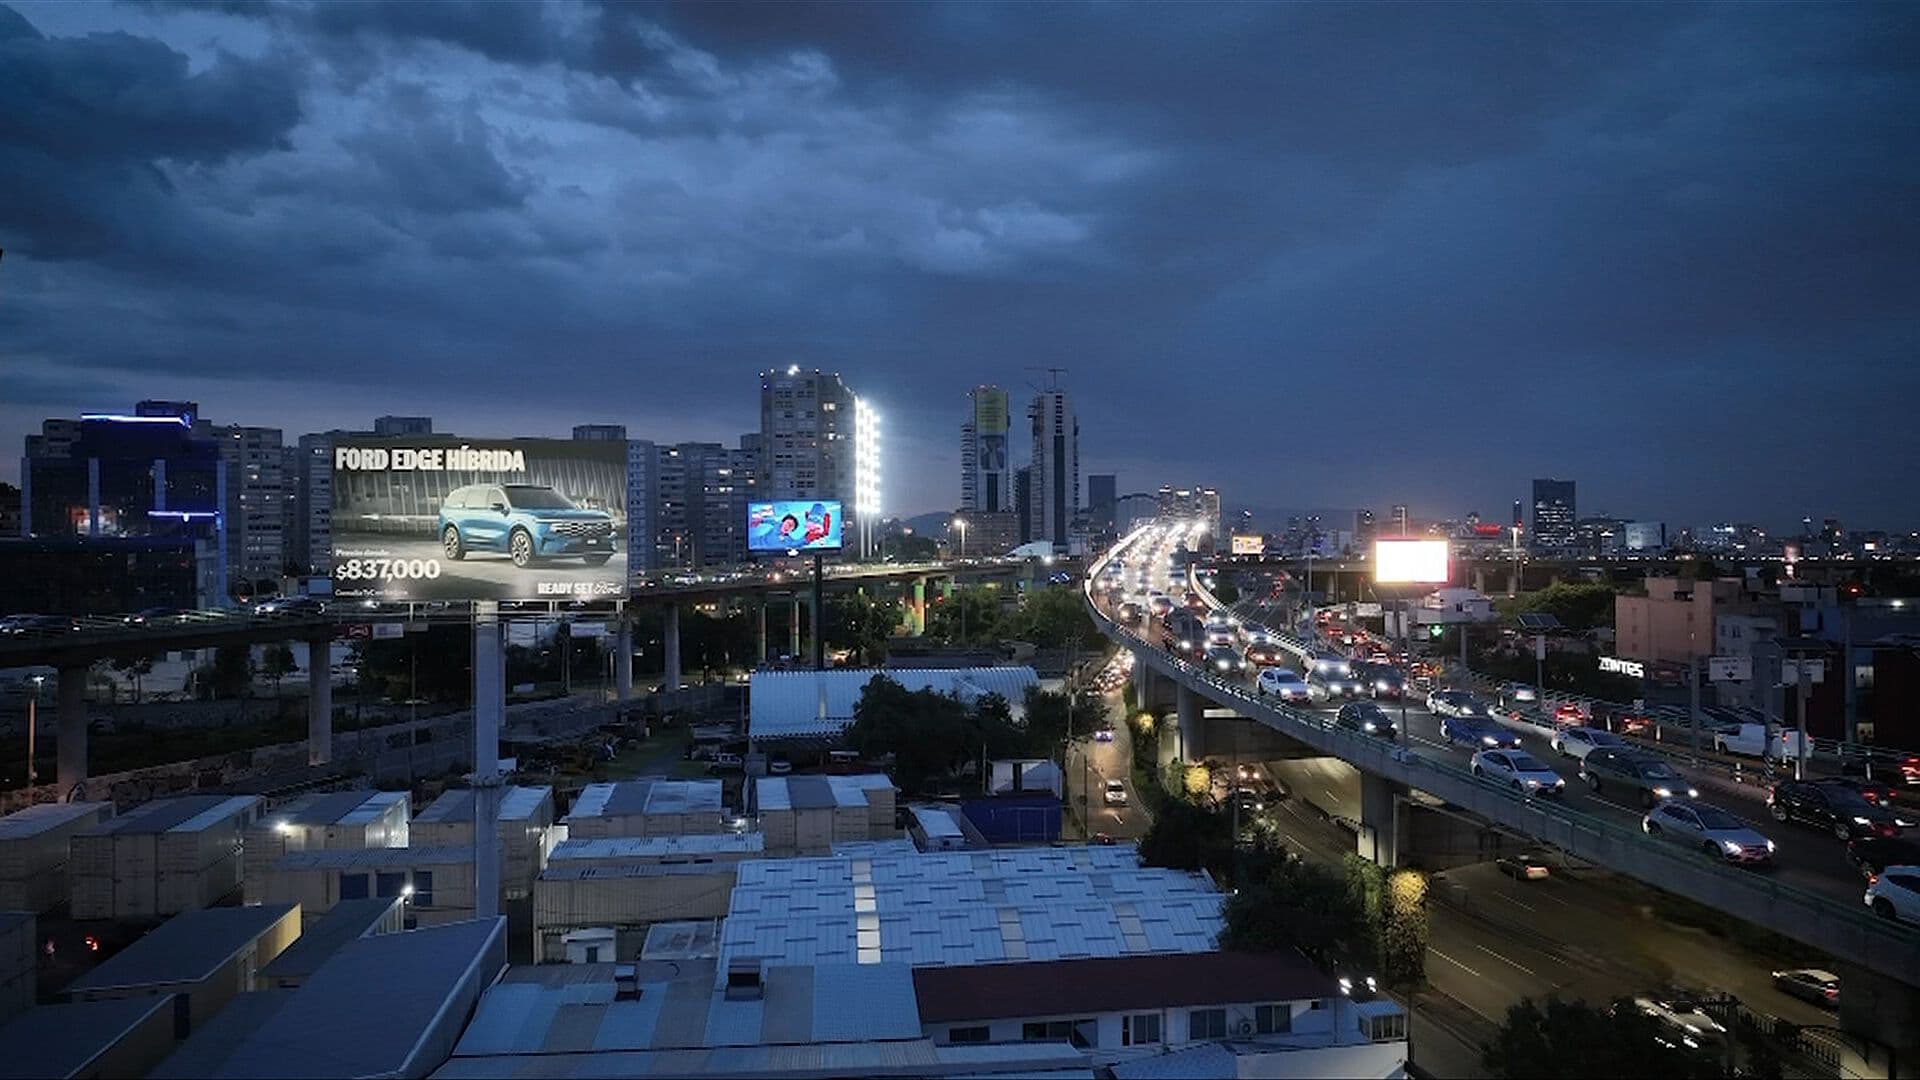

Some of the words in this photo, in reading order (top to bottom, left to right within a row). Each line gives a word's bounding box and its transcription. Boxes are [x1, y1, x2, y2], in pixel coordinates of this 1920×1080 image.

[335, 447, 389, 470] FORD
[391, 447, 443, 470] EDGE
[445, 444, 526, 471] HÍBRIDA
[335, 559, 441, 582] $837,000
[537, 582, 573, 595] READY
[573, 582, 594, 595] SET
